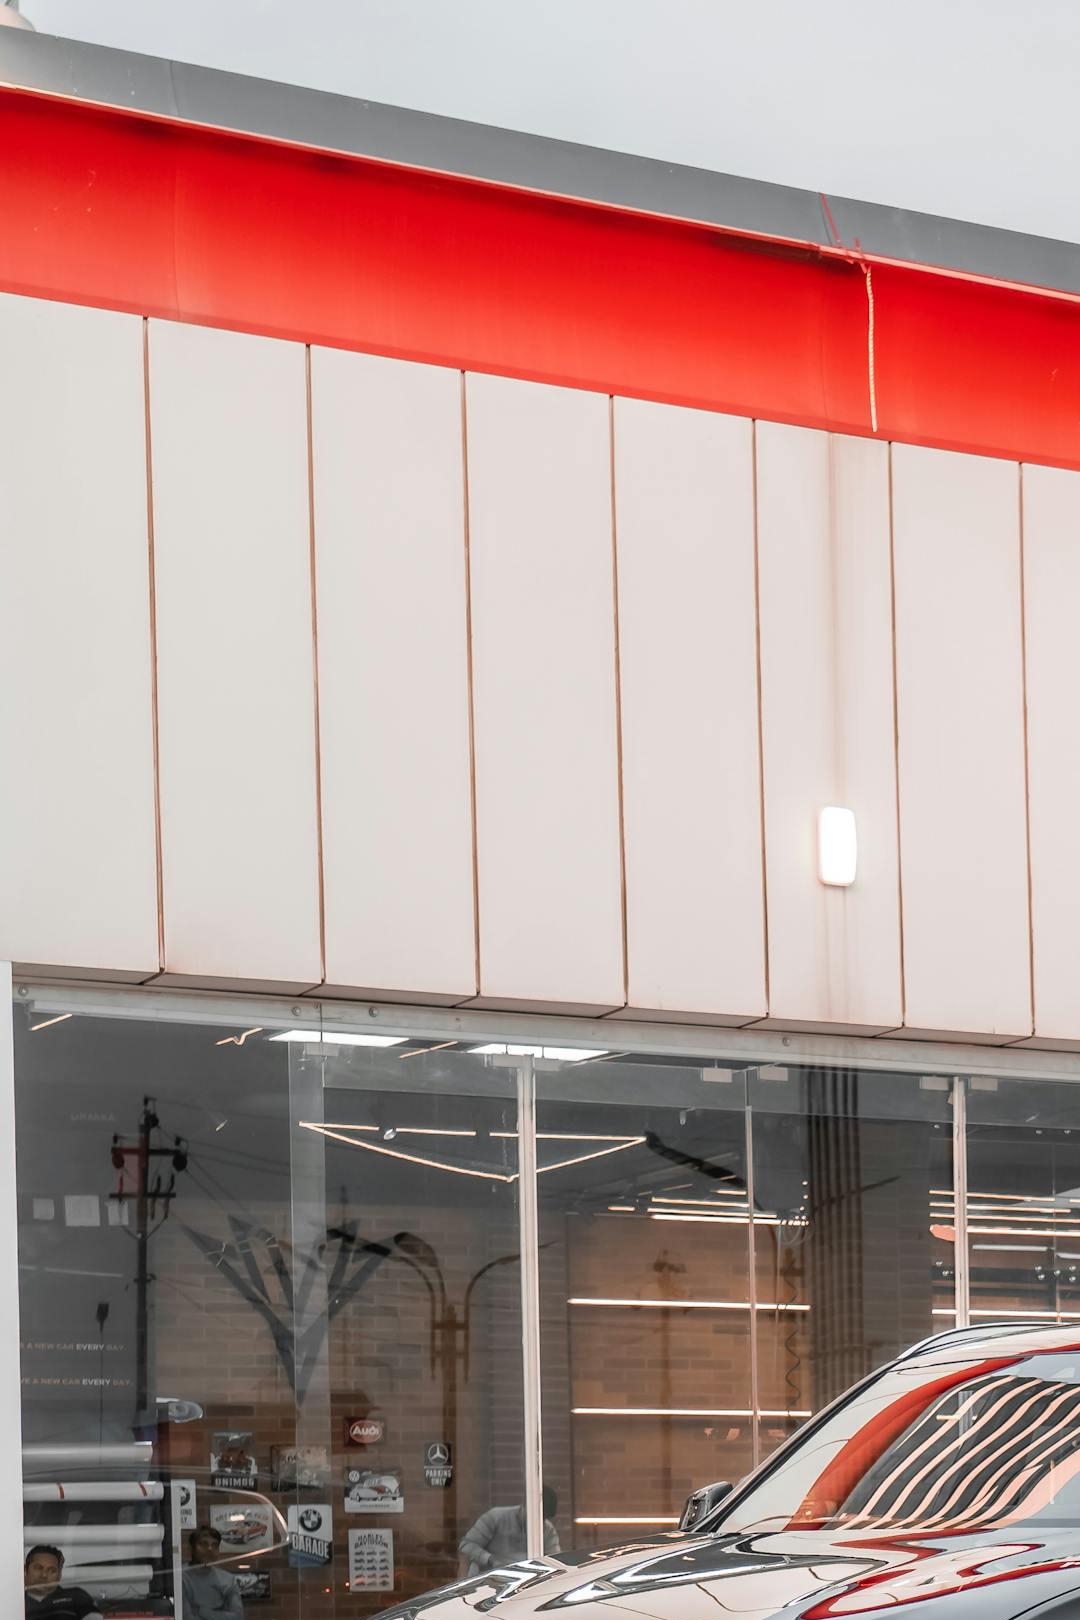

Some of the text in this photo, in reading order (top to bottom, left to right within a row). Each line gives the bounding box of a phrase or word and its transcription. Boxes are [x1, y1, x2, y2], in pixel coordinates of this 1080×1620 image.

[425, 1469, 452, 1478] PARKING
[430, 1478, 447, 1487] ONLY
[292, 1533, 329, 1559] GARAGE
